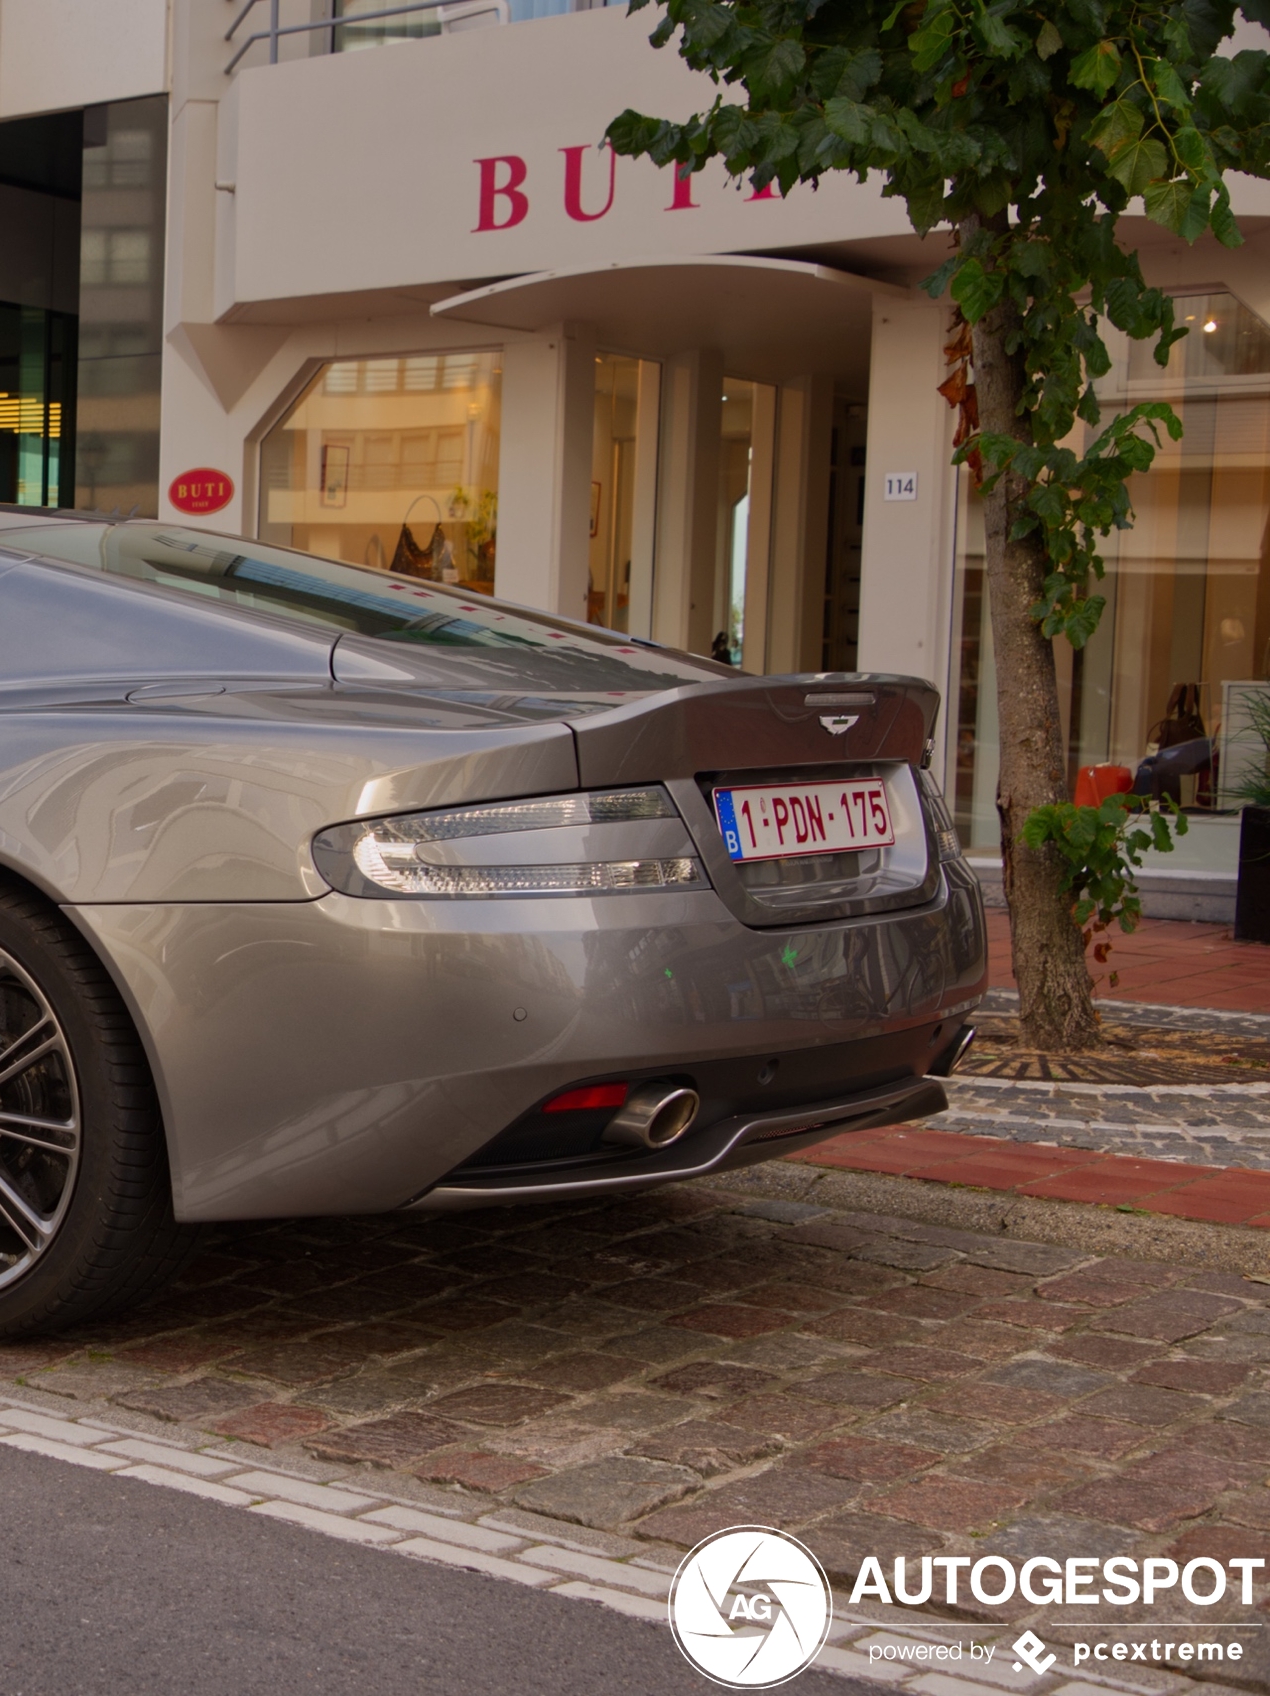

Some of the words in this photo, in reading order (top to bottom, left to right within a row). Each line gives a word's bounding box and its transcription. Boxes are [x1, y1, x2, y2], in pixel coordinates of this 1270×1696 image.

[470, 141, 781, 233] BU
[178, 482, 224, 498] BUTI
[887, 478, 914, 495] 114
[725, 830, 739, 853] B
